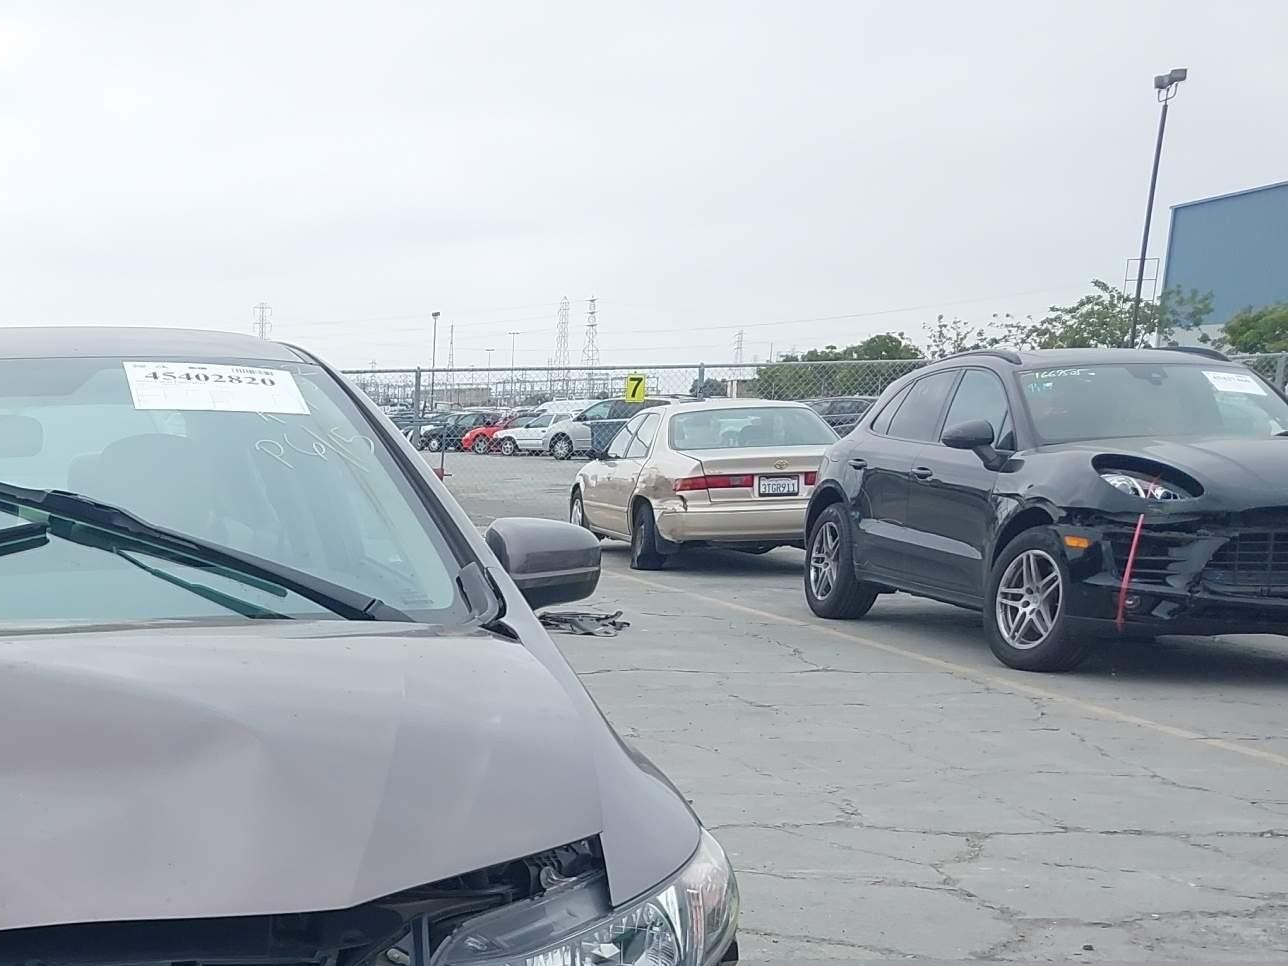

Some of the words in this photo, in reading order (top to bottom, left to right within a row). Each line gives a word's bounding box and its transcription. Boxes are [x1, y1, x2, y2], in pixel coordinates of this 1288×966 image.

[145, 371, 276, 387] 45402820
[629, 377, 643, 398] 7
[761, 483, 795, 493] 3TGR911
